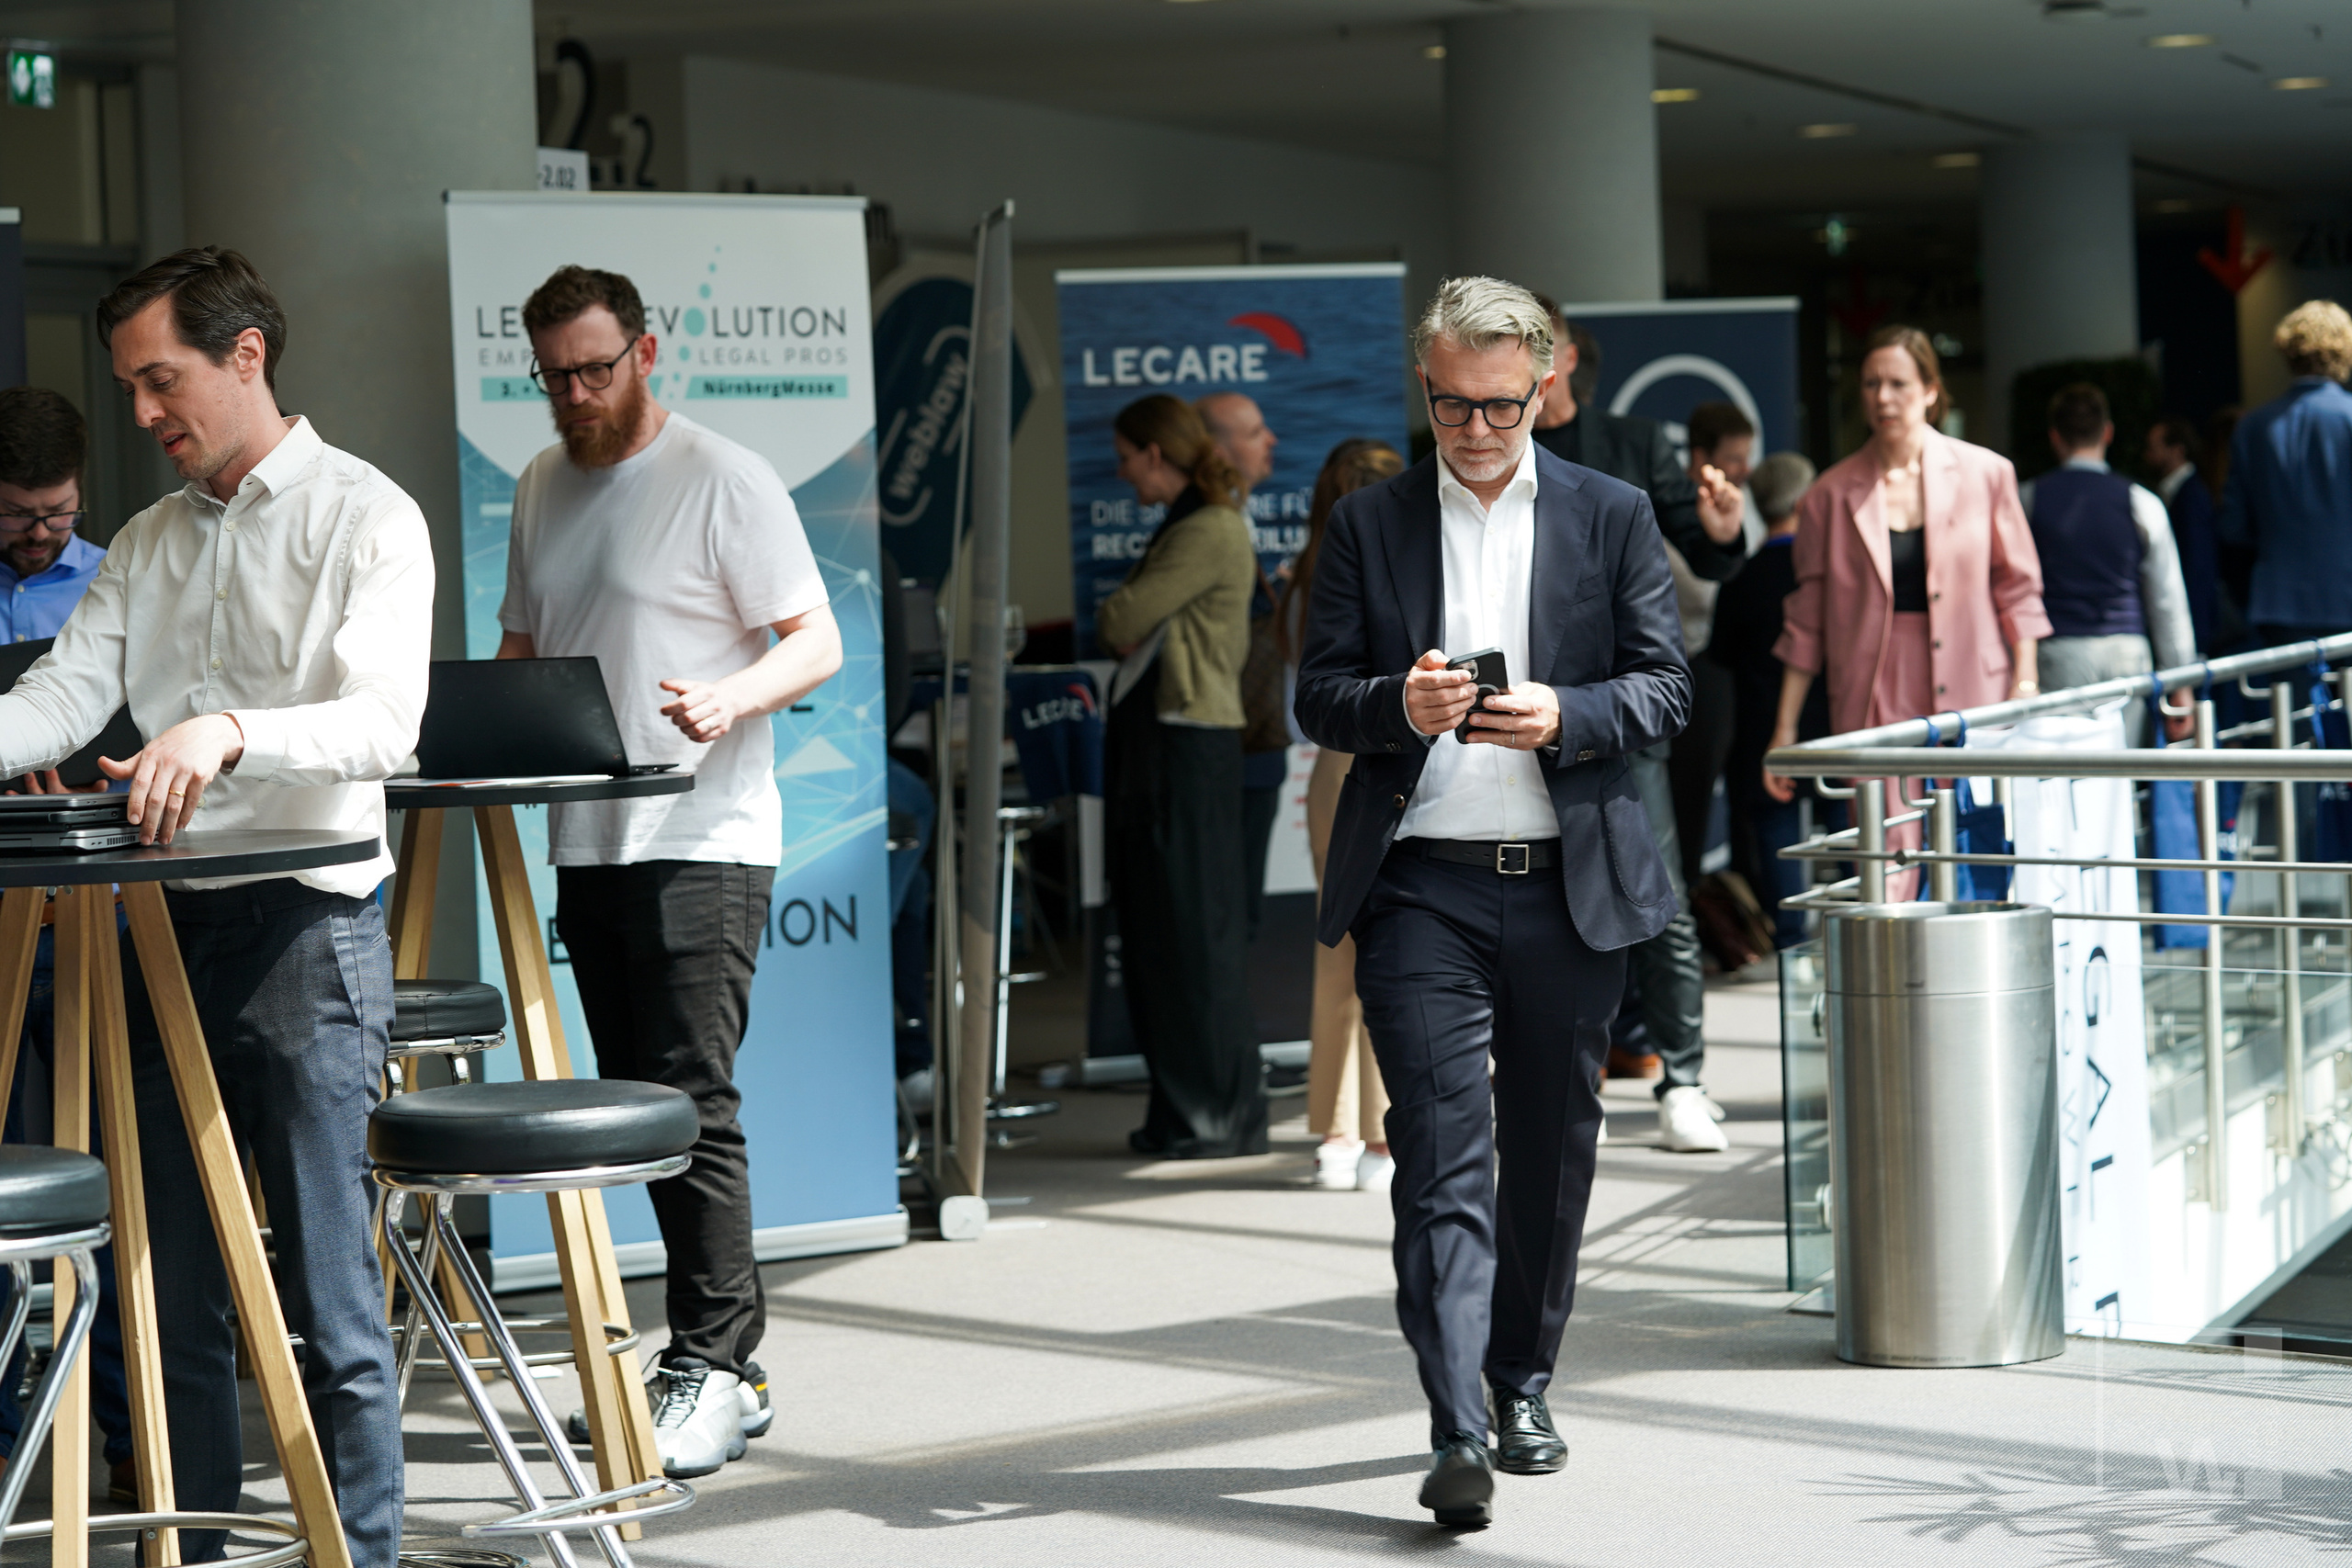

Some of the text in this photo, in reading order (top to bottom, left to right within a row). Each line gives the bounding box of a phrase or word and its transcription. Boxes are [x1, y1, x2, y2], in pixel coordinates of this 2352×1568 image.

[477, 306, 521, 338] LE
[699, 348, 770, 365] LEGAL
[785, 347, 847, 365] PROS
[1082, 343, 1269, 387] LECARE
[703, 378, 835, 399] NürnbergMesse
[1091, 499, 1136, 527] DIE
[1091, 531, 1150, 559] REC
